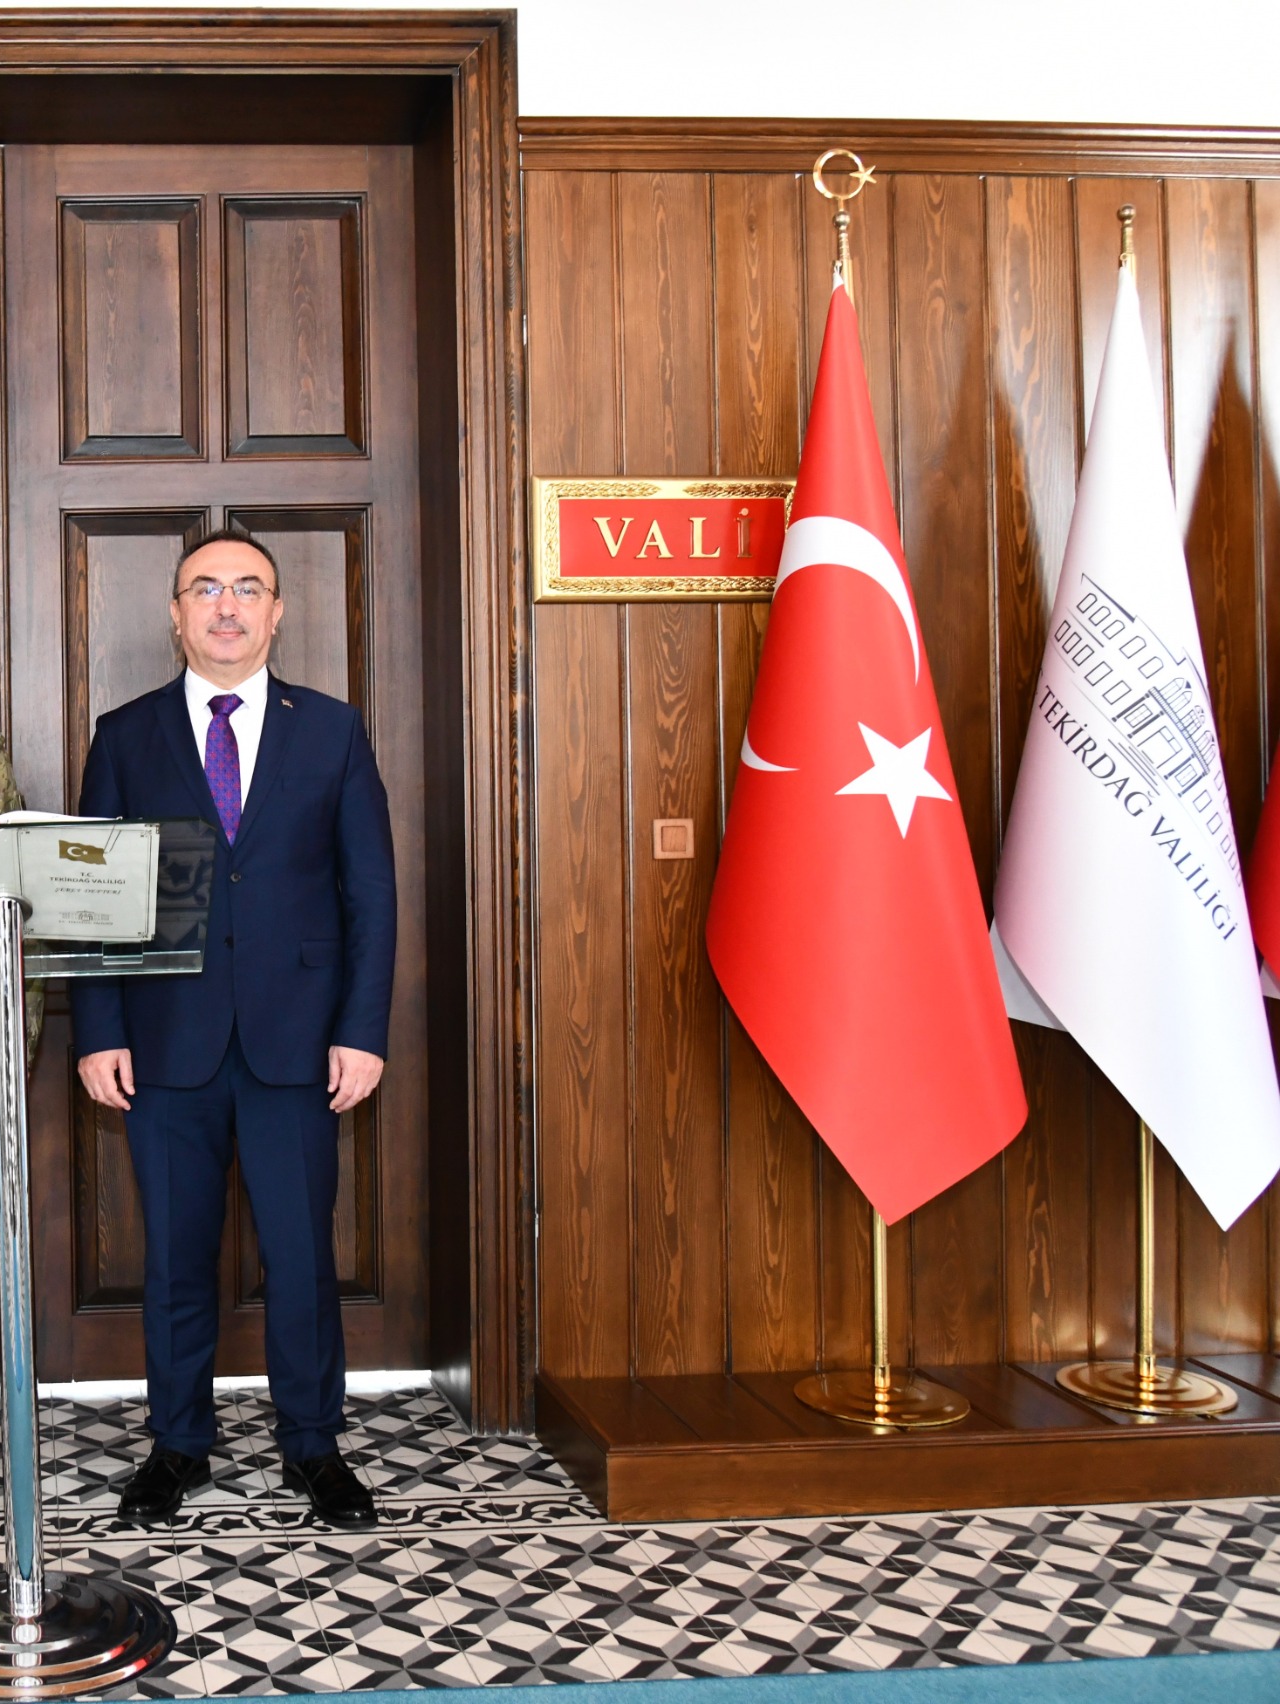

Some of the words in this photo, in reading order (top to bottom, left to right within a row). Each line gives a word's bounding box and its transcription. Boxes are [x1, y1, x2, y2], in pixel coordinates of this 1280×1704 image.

[592, 507, 753, 559] VALİ
[1038, 684, 1155, 818] TEKİRDAĞ
[1150, 814, 1239, 941] VALİLİĞİ
